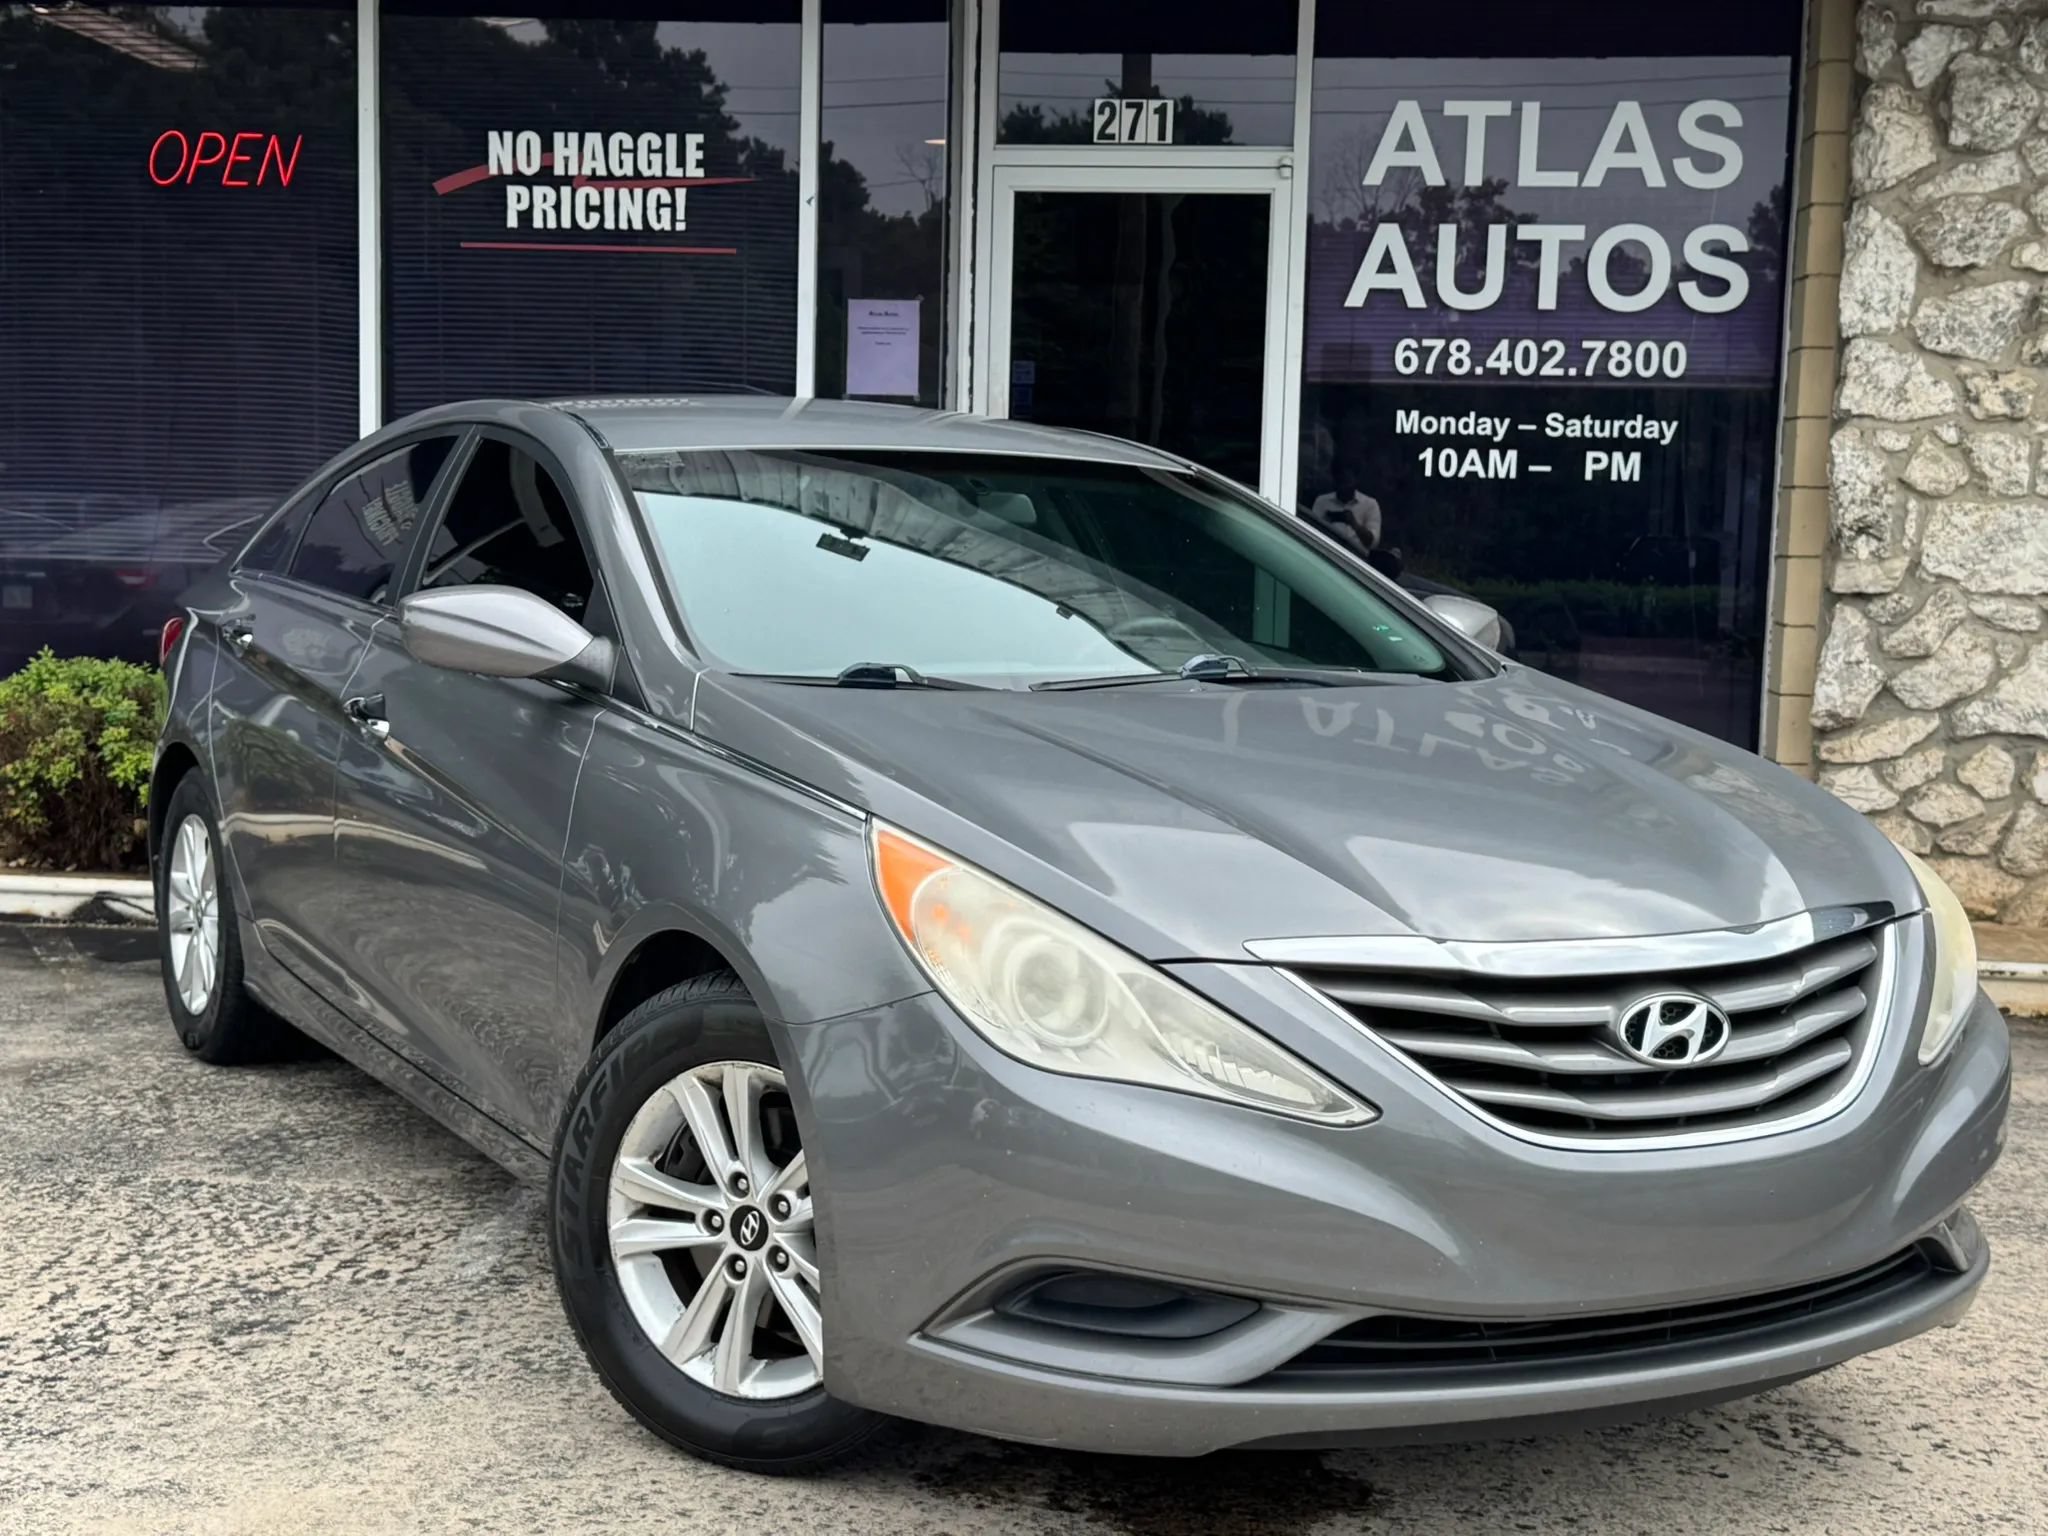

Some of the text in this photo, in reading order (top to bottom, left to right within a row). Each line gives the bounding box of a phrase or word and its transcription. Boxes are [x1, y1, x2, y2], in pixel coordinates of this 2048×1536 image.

[1096, 101, 1168, 141] 271
[1362, 100, 1743, 189] ATLAS
[148, 129, 303, 188] OPEN
[488, 130, 705, 179] NO HAGGLE
[506, 184, 688, 232] PRICING!
[1344, 223, 1749, 313] AUTOS
[1394, 338, 1688, 378] 678.402.7800
[1395, 409, 1511, 443] Monday
[1544, 412, 1679, 445] Saturday
[1418, 447, 1518, 480] 10AM
[1584, 451, 1642, 482] PM
